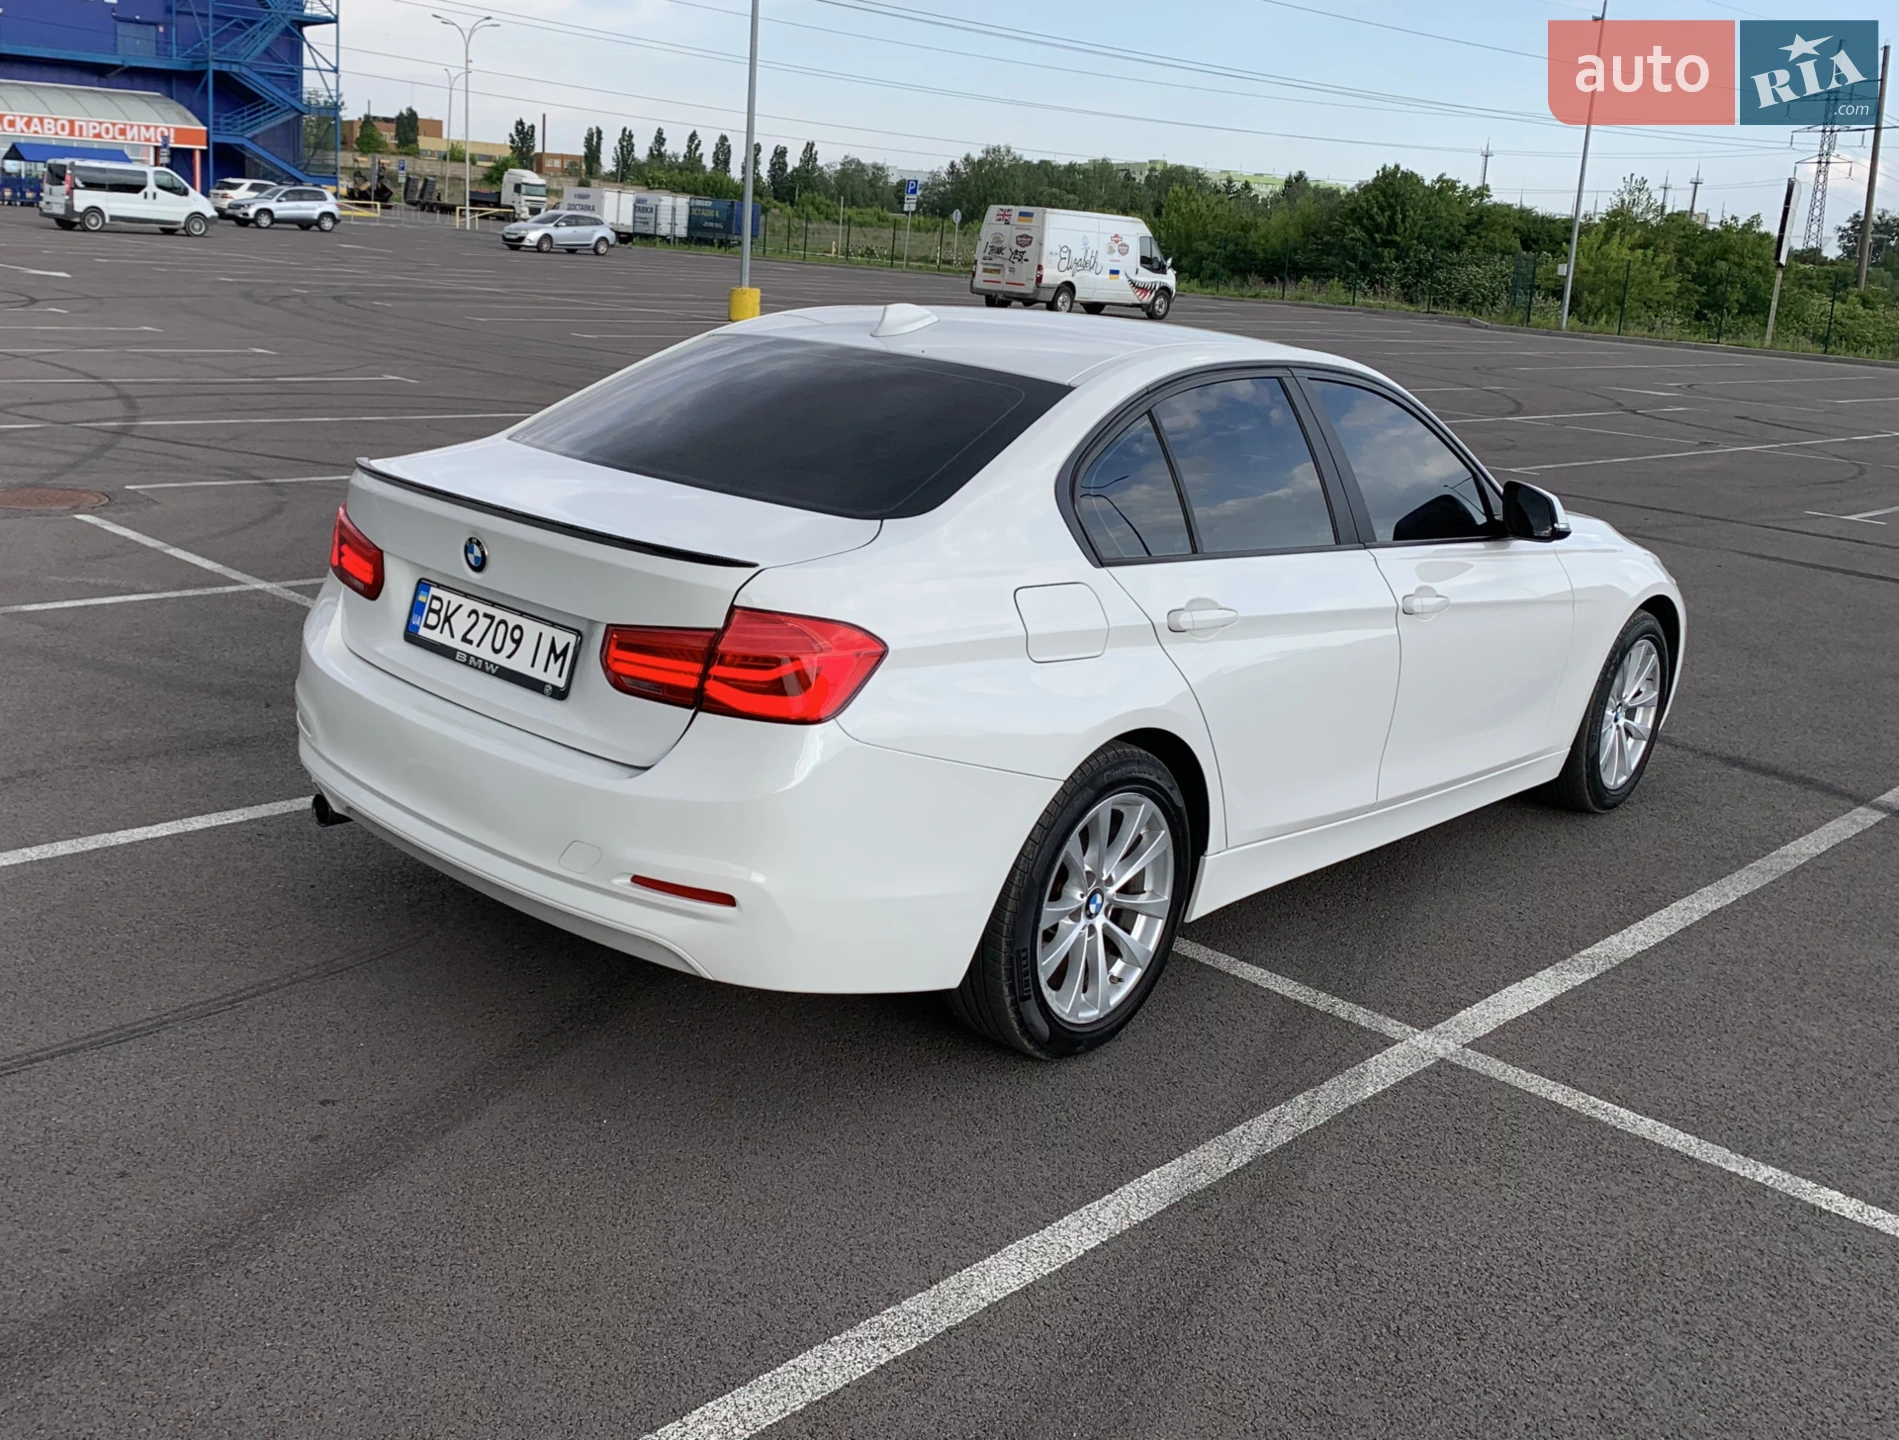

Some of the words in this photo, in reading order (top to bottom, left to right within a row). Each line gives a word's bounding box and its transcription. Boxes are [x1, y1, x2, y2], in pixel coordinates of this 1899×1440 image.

[0, 114, 70, 136] СКАВО
[74, 120, 176, 143] ПРОСИМО!
[1057, 244, 1104, 278] Elizabeth
[411, 615, 421, 627] UA
[423, 594, 463, 639] BK
[460, 608, 525, 660] 2709
[531, 631, 571, 679] IM
[455, 651, 499, 675] BMW
